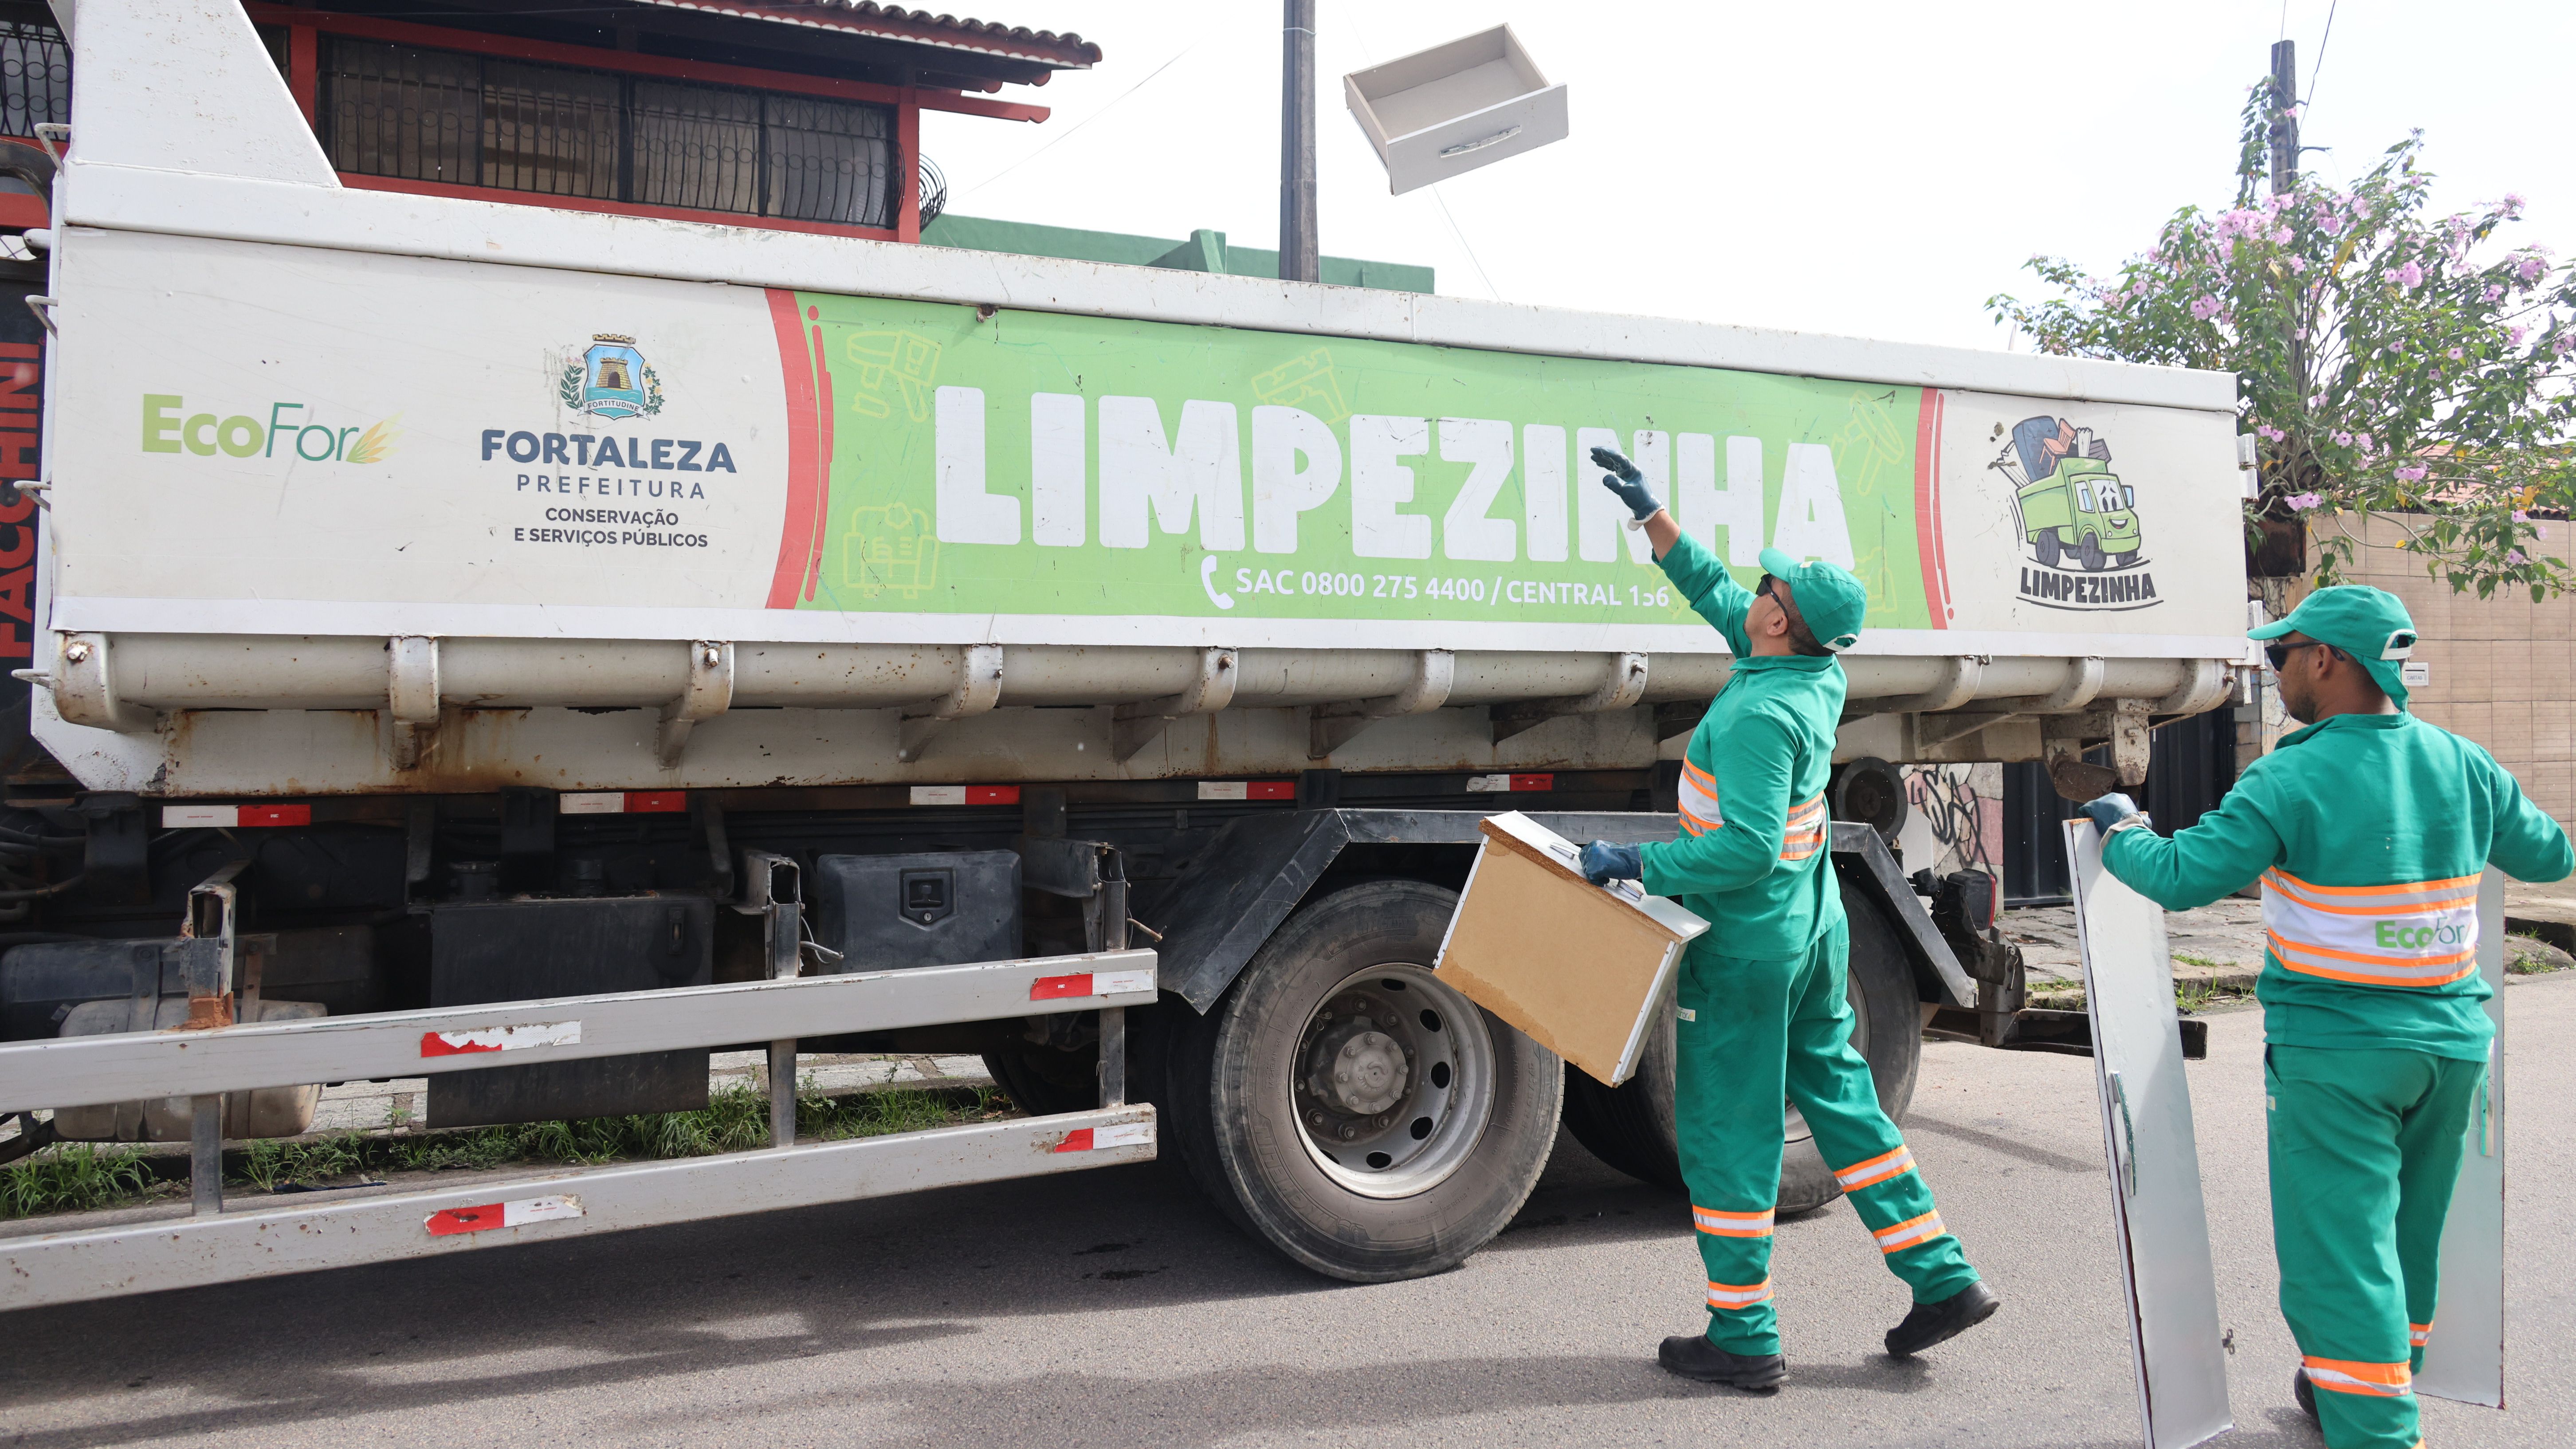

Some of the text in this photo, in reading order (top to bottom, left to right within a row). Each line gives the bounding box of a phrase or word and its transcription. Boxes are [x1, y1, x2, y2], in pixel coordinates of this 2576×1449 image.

[588, 401, 639, 412] FORTITUDINE
[142, 393, 359, 461] EcoFor
[482, 429, 737, 473] FORTALEZA
[518, 474, 704, 499] PREFEITURA
[935, 385, 1855, 571] LIMPEZINHA
[0, 342, 39, 658] FACCHINI
[546, 508, 679, 528] CONSERVAÇÃO
[514, 528, 708, 548] E SERVIÇOS PÚBLICOS
[1236, 568, 1294, 595] SAC
[1301, 571, 1365, 597] 0800
[1372, 575, 1418, 599] 275
[1425, 577, 1485, 601] 4400
[2021, 567, 2156, 603] LIMPEZINHA
[2376, 916, 2465, 949] EcoFor
[1268, 1052, 1278, 1089] MICHELIN
[1254, 1126, 1338, 1232] MICHELIN
